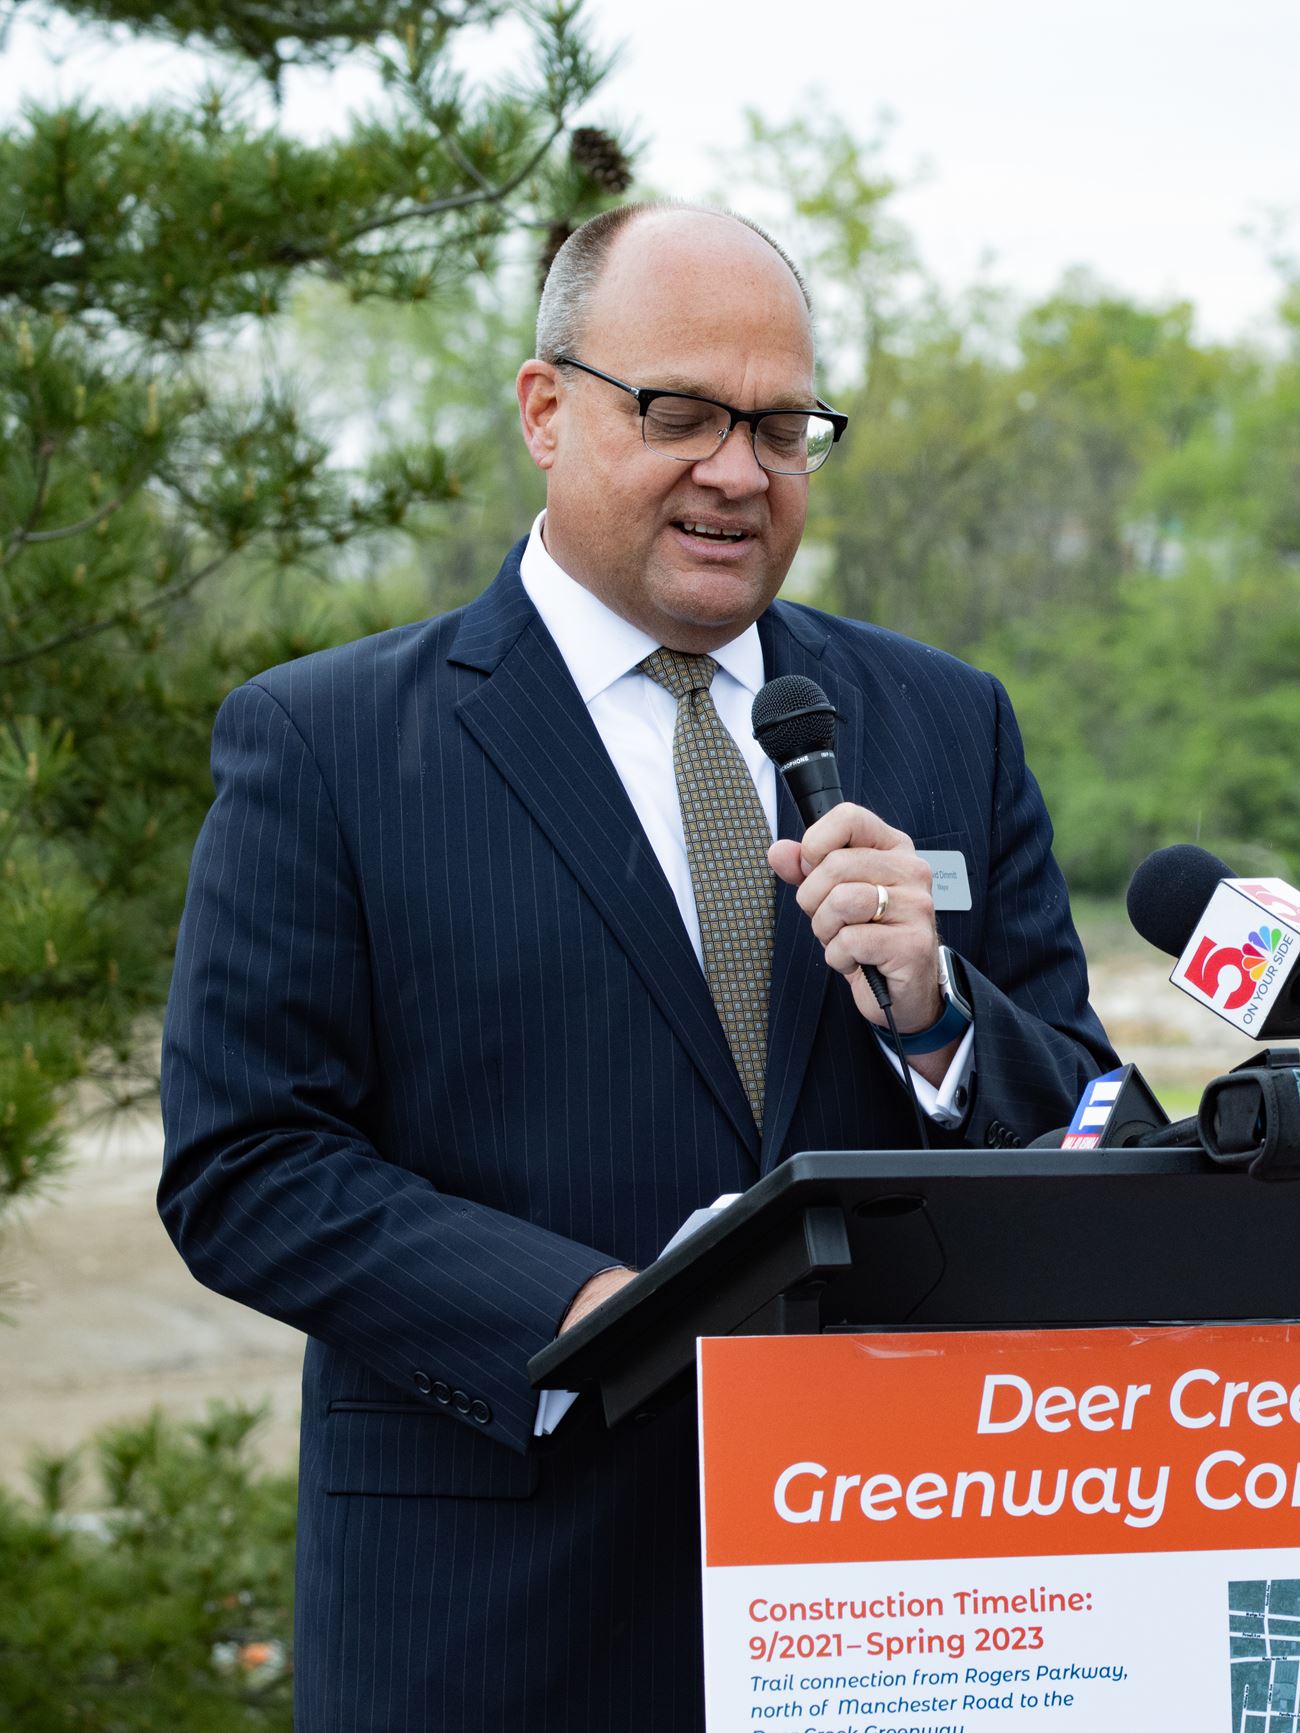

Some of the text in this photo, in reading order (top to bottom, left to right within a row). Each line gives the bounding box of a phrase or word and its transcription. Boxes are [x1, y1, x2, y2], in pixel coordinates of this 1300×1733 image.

[1184, 935, 1257, 1010] 5
[1242, 934, 1294, 1025] ON YOUR SIDE
[977, 1374, 1151, 1434] Deer
[774, 1462, 1169, 1528] Greenway
[748, 1586, 1092, 1623] Construction Timeline:
[975, 1626, 1044, 1652] 2023
[750, 1663, 1128, 1692] Trail connection from Rogers Parkway,
[750, 1690, 1075, 1719] north of Manchester Road to the
